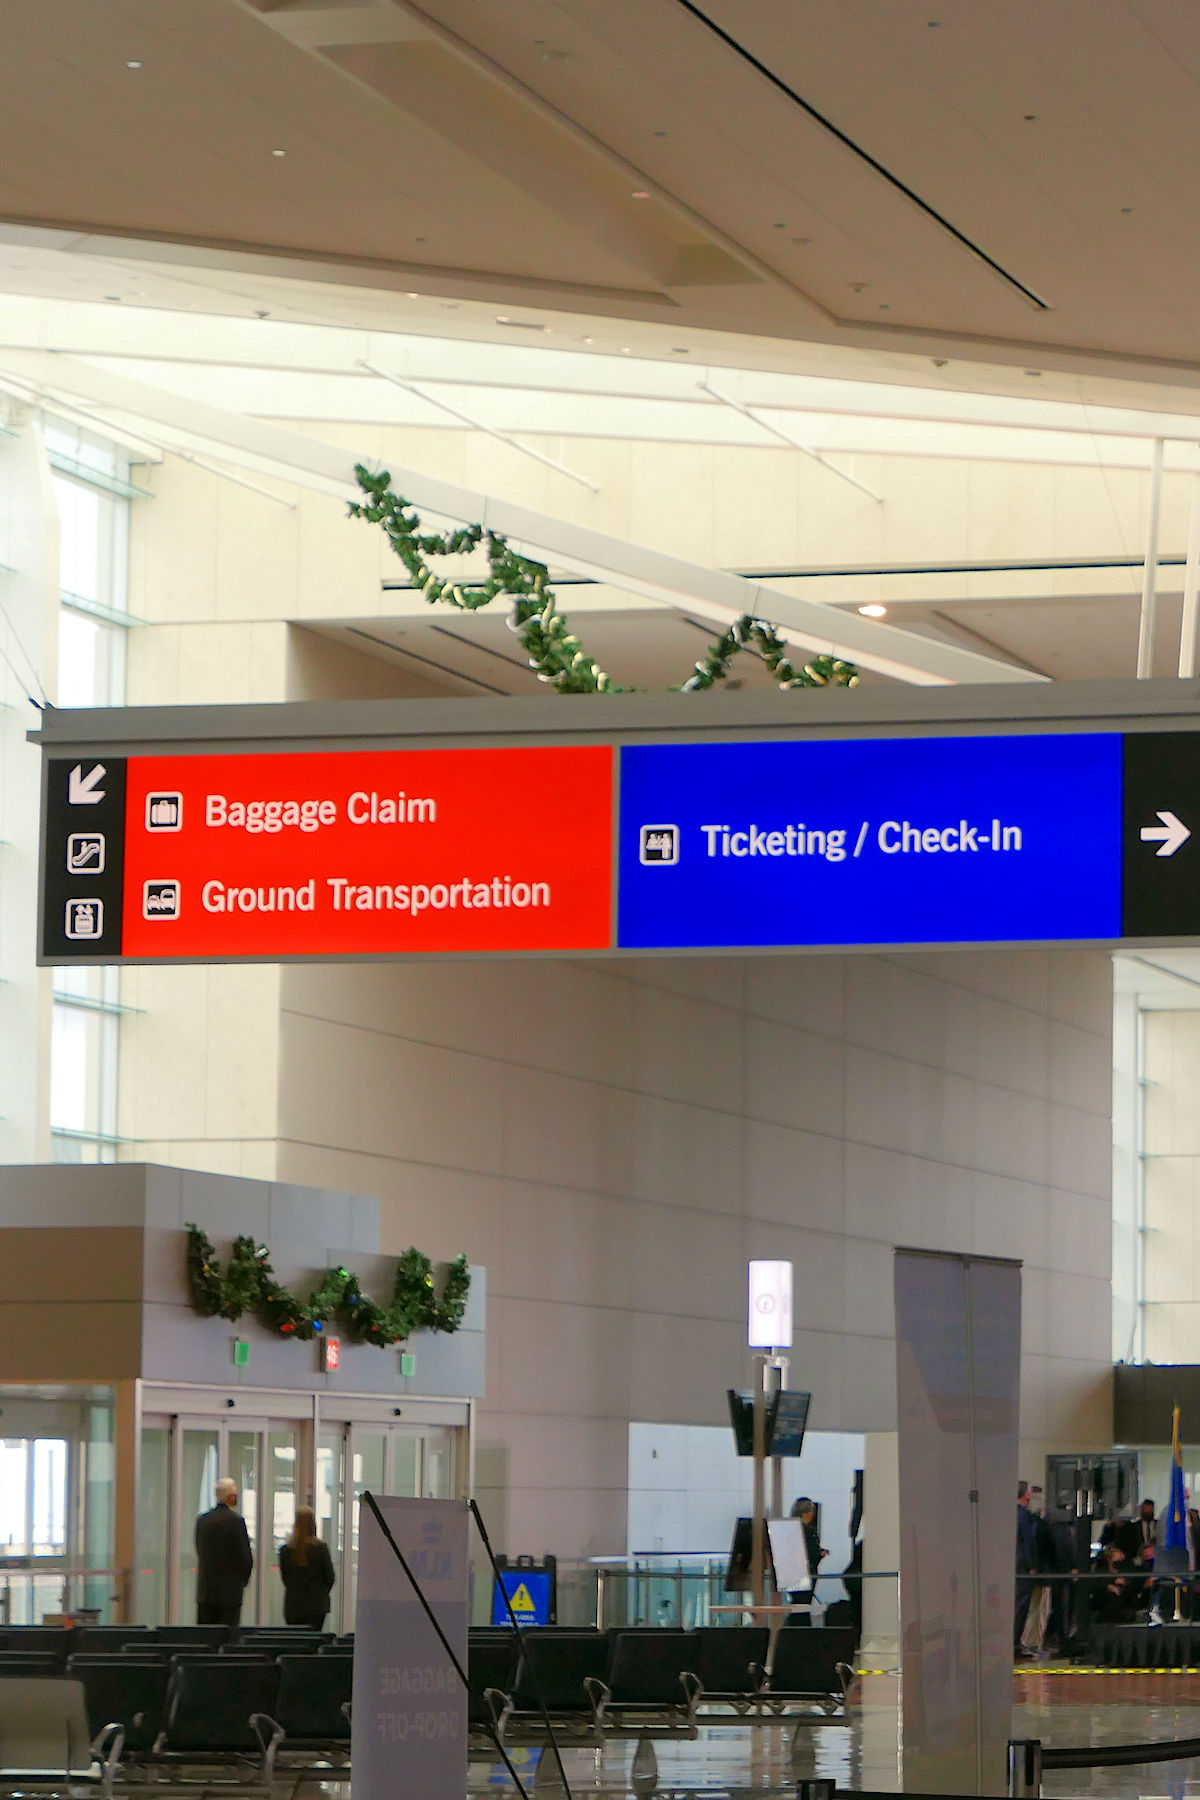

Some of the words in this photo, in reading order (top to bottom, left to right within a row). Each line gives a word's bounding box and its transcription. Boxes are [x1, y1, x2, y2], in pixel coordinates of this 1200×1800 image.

[204, 794, 337, 834] Baggage
[346, 791, 438, 825] Claim
[700, 823, 847, 863] Ticketing
[852, 821, 870, 859] /
[876, 818, 1024, 854] Check-In
[200, 878, 317, 914] Ground
[326, 875, 551, 917] Transportation
